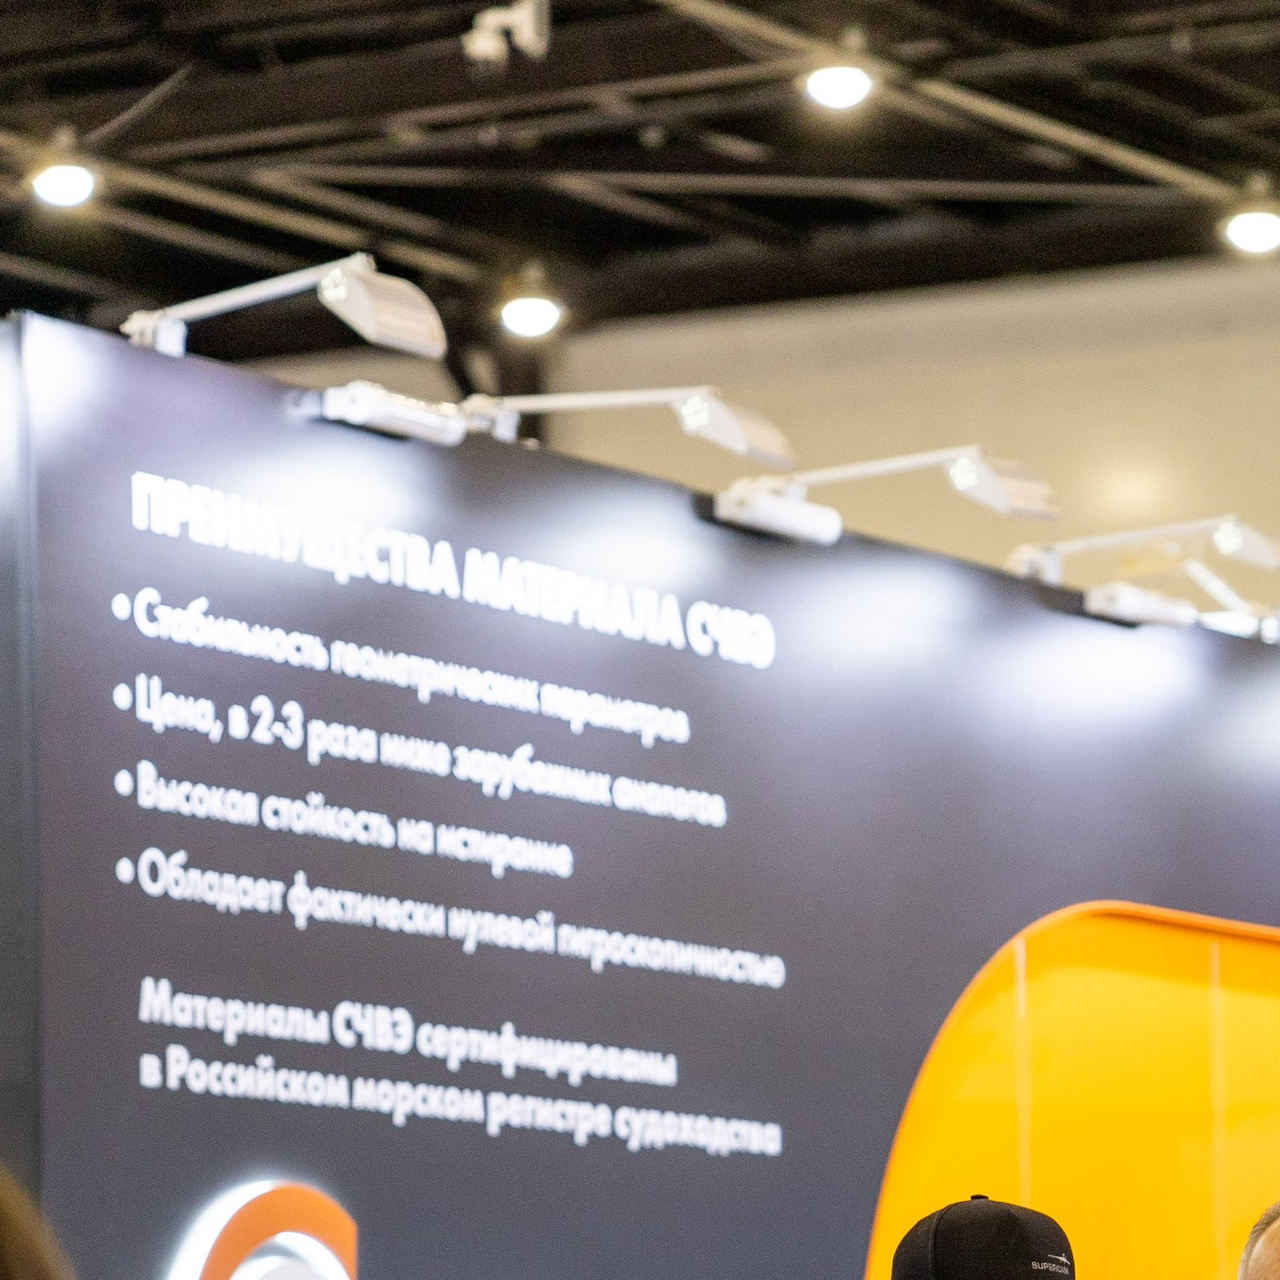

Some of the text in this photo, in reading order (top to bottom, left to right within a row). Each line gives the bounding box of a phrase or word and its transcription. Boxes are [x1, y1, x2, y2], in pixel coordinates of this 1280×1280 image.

[131, 471, 461, 599] ПРЕИМУЩЕСТВА
[462, 547, 686, 650] МАТЕРИАЛА
[133, 587, 329, 671] Стабильность
[135, 673, 223, 743] Цена,
[228, 704, 249, 740] в
[250, 695, 305, 750] 2-3
[307, 718, 378, 766] раза
[137, 758, 260, 827] Высокая
[260, 790, 396, 848] стойкость
[397, 817, 435, 855] на
[137, 847, 286, 914] Обладает
[287, 870, 447, 938] фактически
[448, 907, 556, 955] нулевой
[138, 975, 678, 1088] Материалы СЧВЭ сертифицированы
[139, 1043, 783, 1157] в Российском морском регистре судоходства
